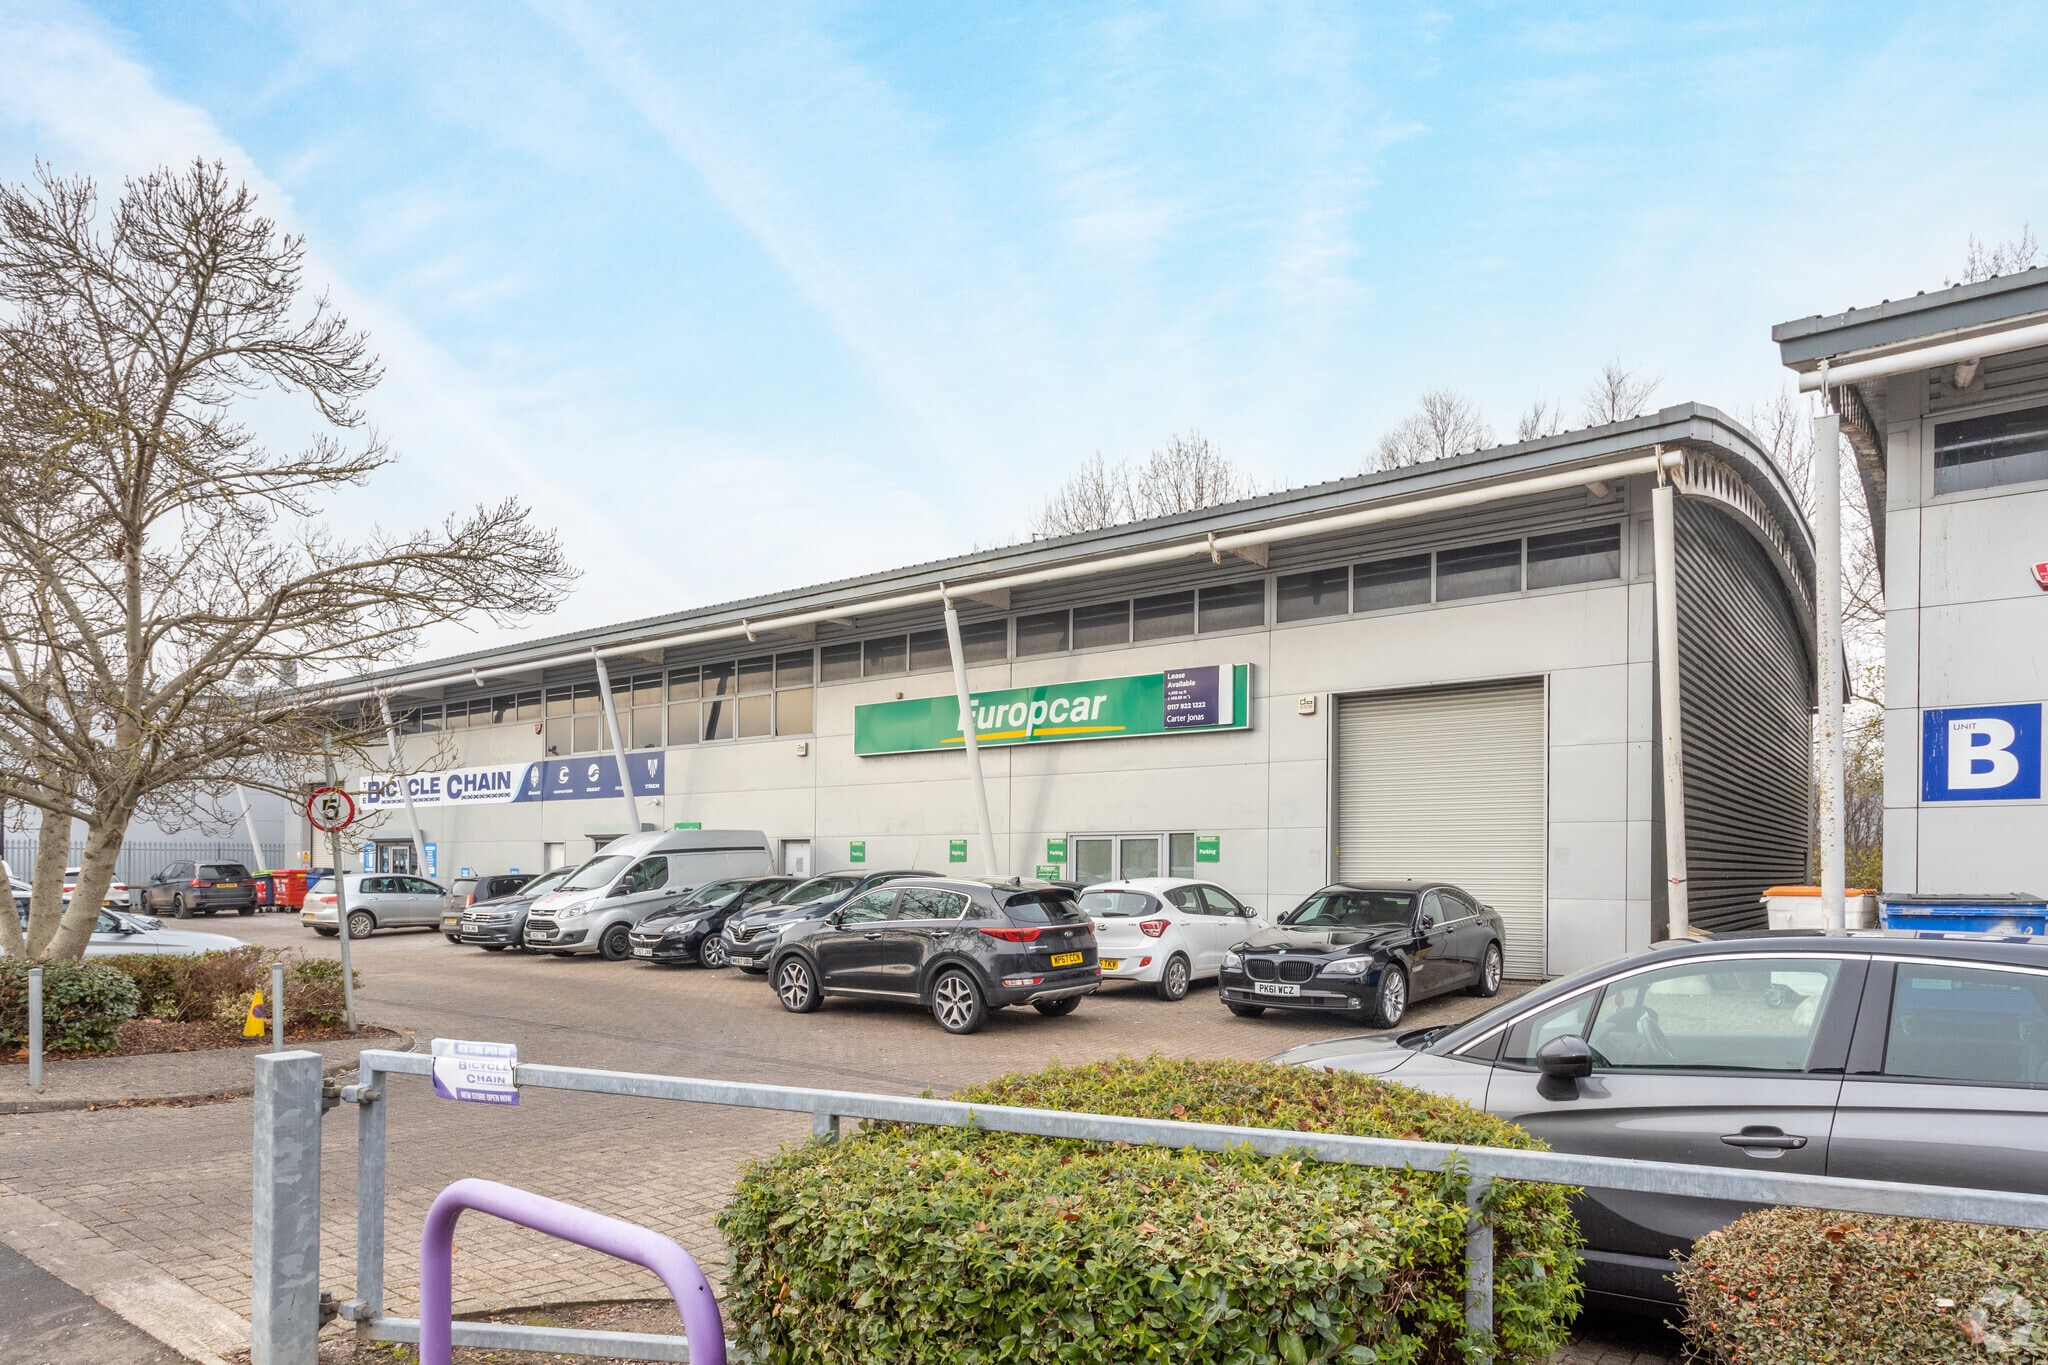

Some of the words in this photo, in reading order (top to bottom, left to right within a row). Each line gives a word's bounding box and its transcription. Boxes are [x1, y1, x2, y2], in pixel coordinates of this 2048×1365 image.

[1167, 680, 1196, 688] Available
[1187, 714, 1204, 722] Jonas
[1953, 723, 1976, 731] UNIT
[1948, 718, 2018, 790] B
[447, 771, 511, 800] CHAIN
[323, 799, 339, 820] 5
[1054, 955, 1069, 964] WP67
[1070, 953, 1080, 962] CCN
[1104, 960, 1116, 968] TKV
[1259, 984, 1276, 994] PK61
[1278, 985, 1294, 995] WCZ
[459, 1061, 510, 1071] BICYCLE
[466, 1074, 505, 1084] CHAIN
[460, 1091, 471, 1099] NEW
[471, 1092, 486, 1100] STORE
[486, 1094, 499, 1102] OPEN
[500, 1094, 512, 1103] NOW
